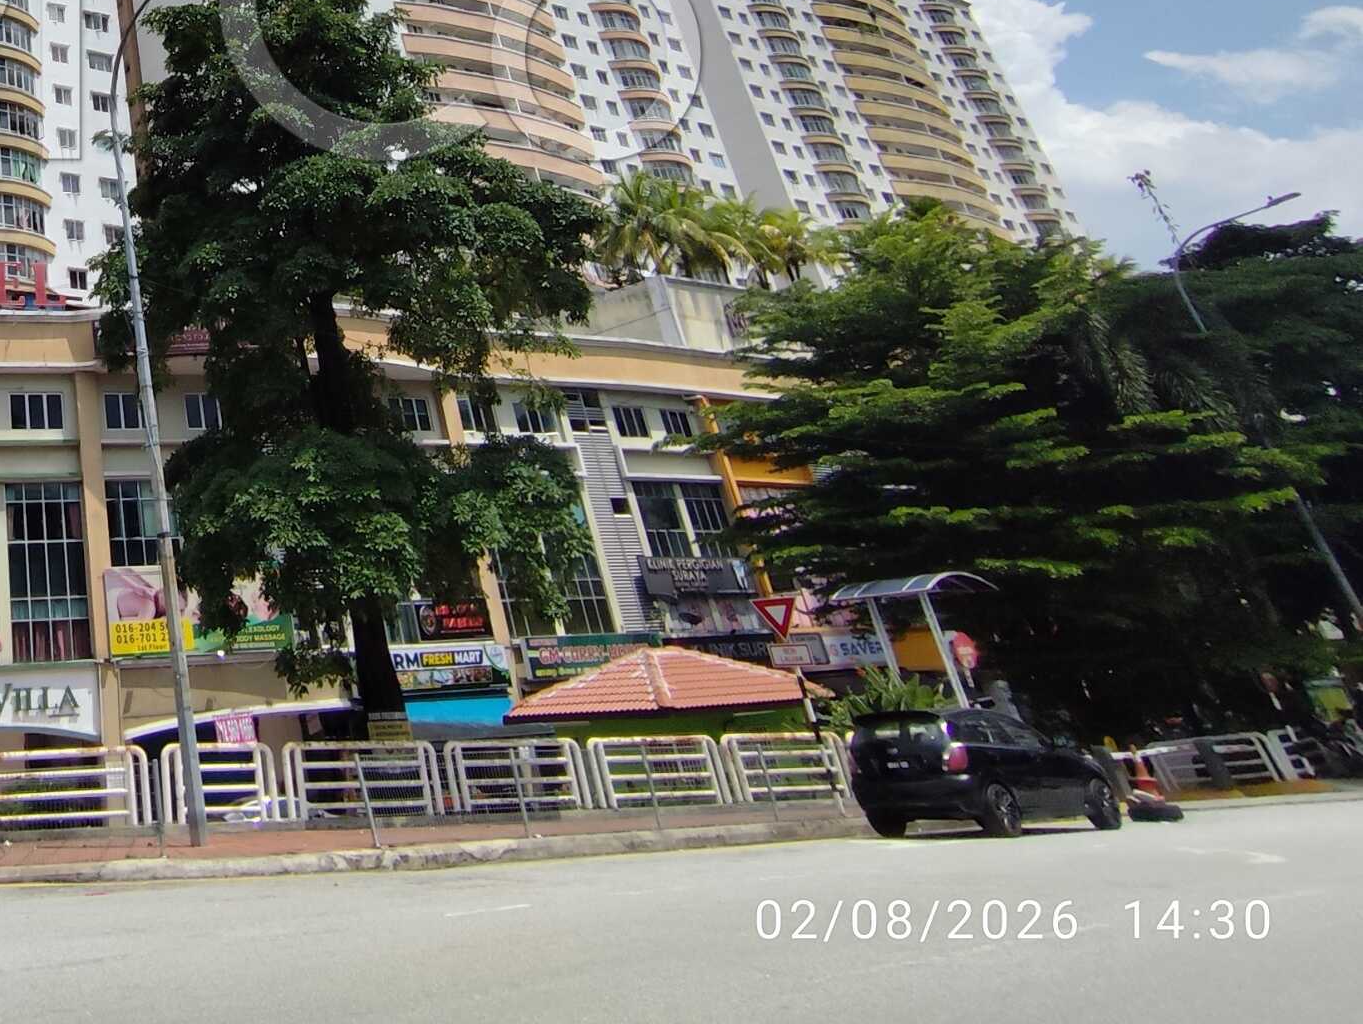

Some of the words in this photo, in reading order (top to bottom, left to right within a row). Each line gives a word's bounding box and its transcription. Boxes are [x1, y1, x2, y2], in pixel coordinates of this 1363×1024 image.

[672, 570, 707, 581] SURAYA
[393, 652, 420, 669] RM
[422, 652, 453, 665] FRESH
[455, 651, 481, 664] MART
